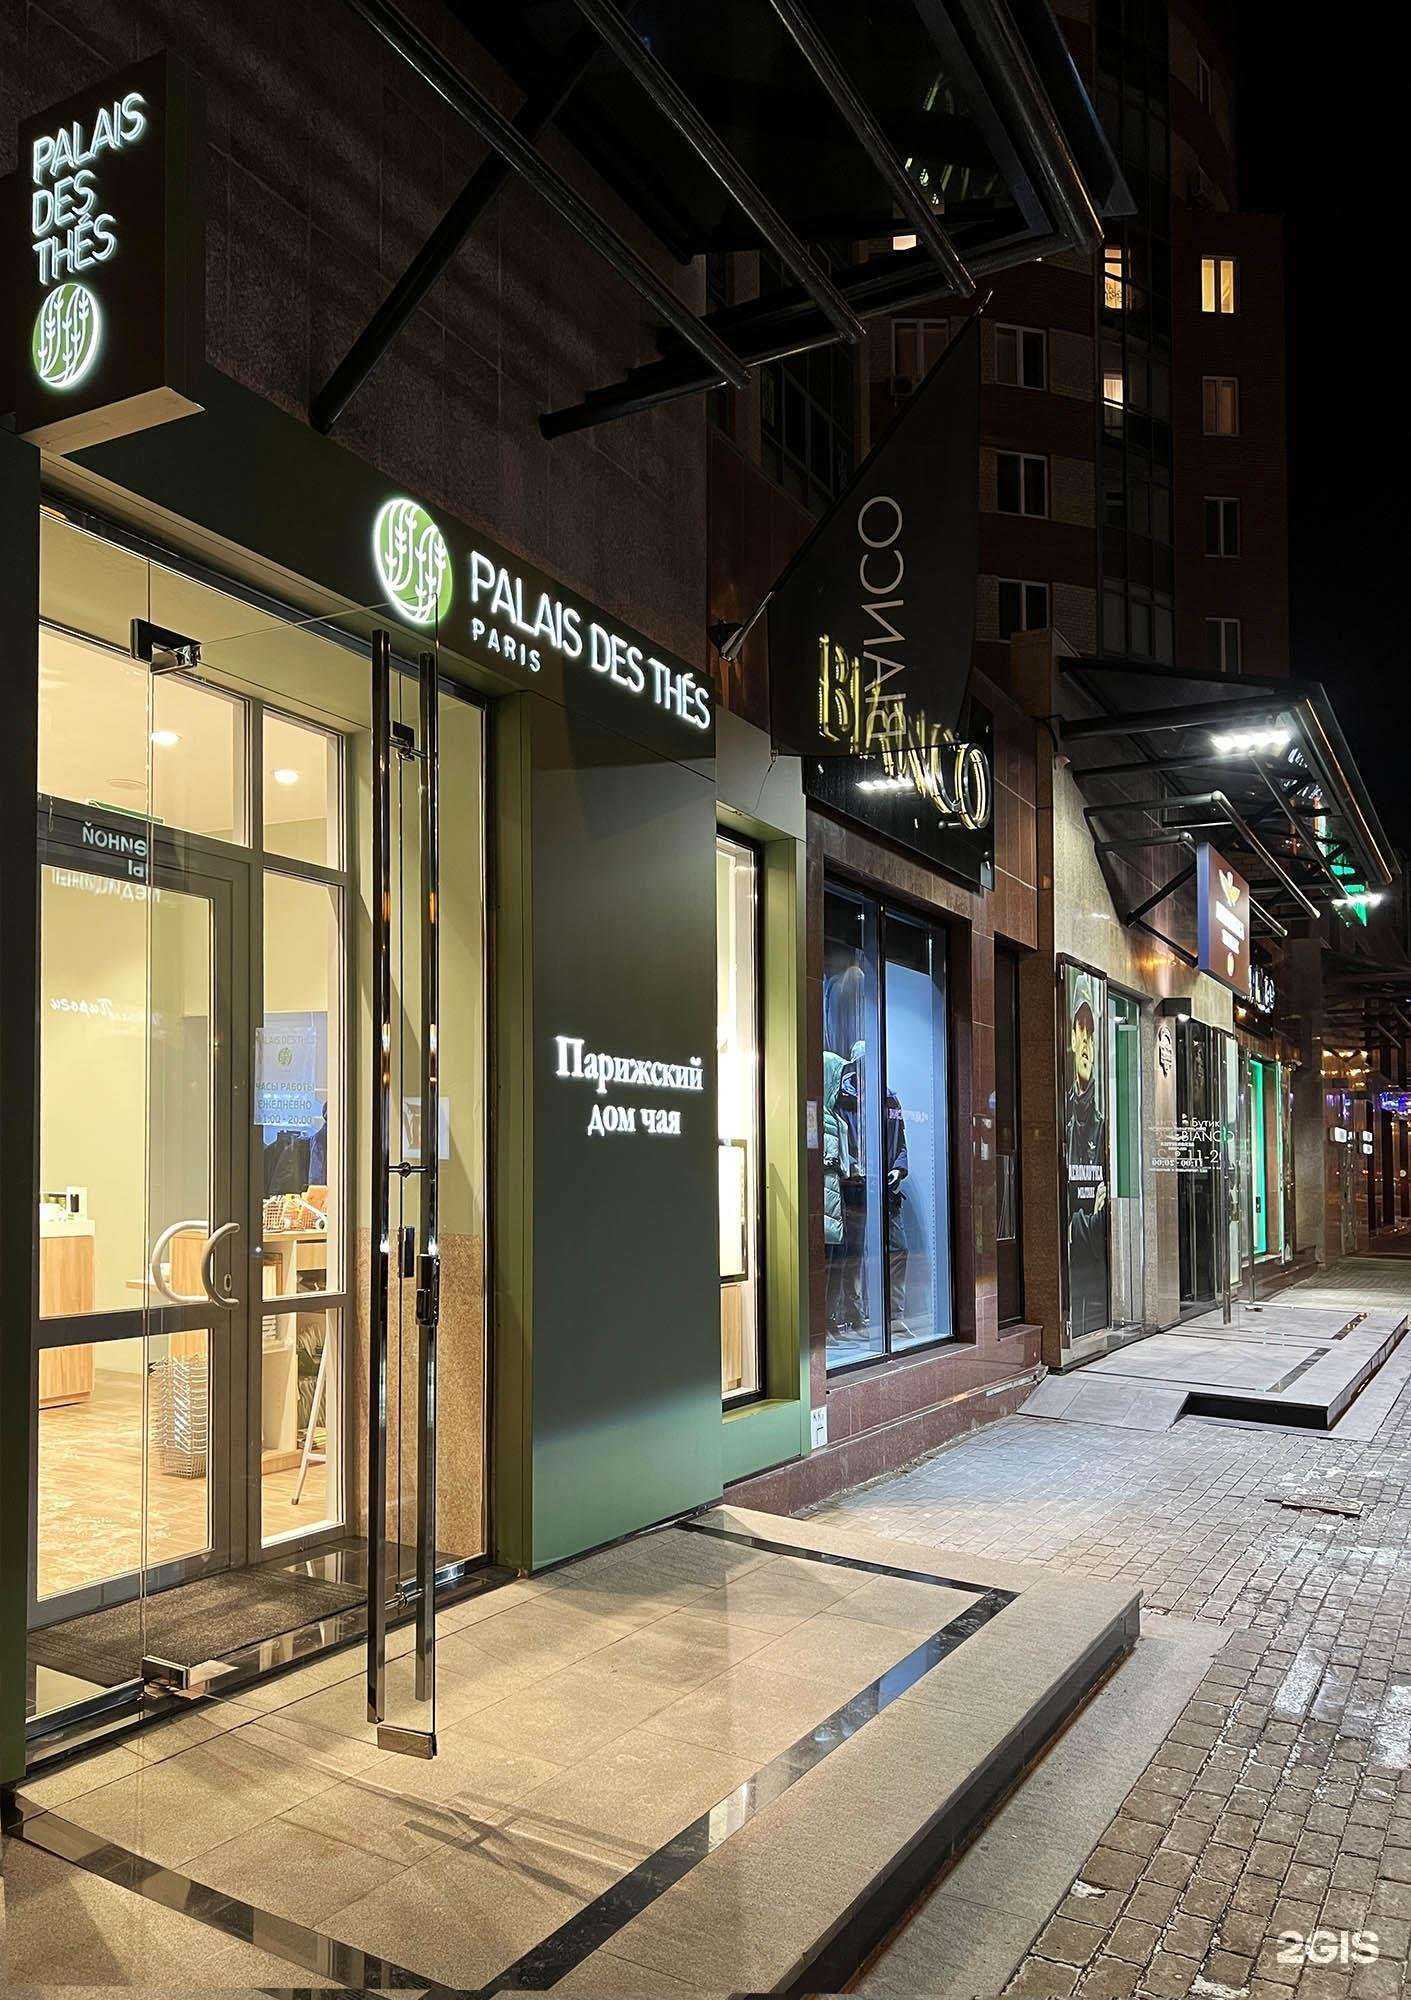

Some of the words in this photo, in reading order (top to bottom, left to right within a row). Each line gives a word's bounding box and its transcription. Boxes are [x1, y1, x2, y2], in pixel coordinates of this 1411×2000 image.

[32, 92, 147, 184] PALAIS
[32, 169, 96, 237] DES
[32, 213, 117, 285] THÉS
[470, 551, 583, 657] PALAIS
[590, 623, 645, 693] DES
[648, 658, 711, 730] THÉS
[471, 618, 541, 673] PARIS
[555, 1036, 704, 1094] Парижский
[640, 1108, 681, 1135] чая
